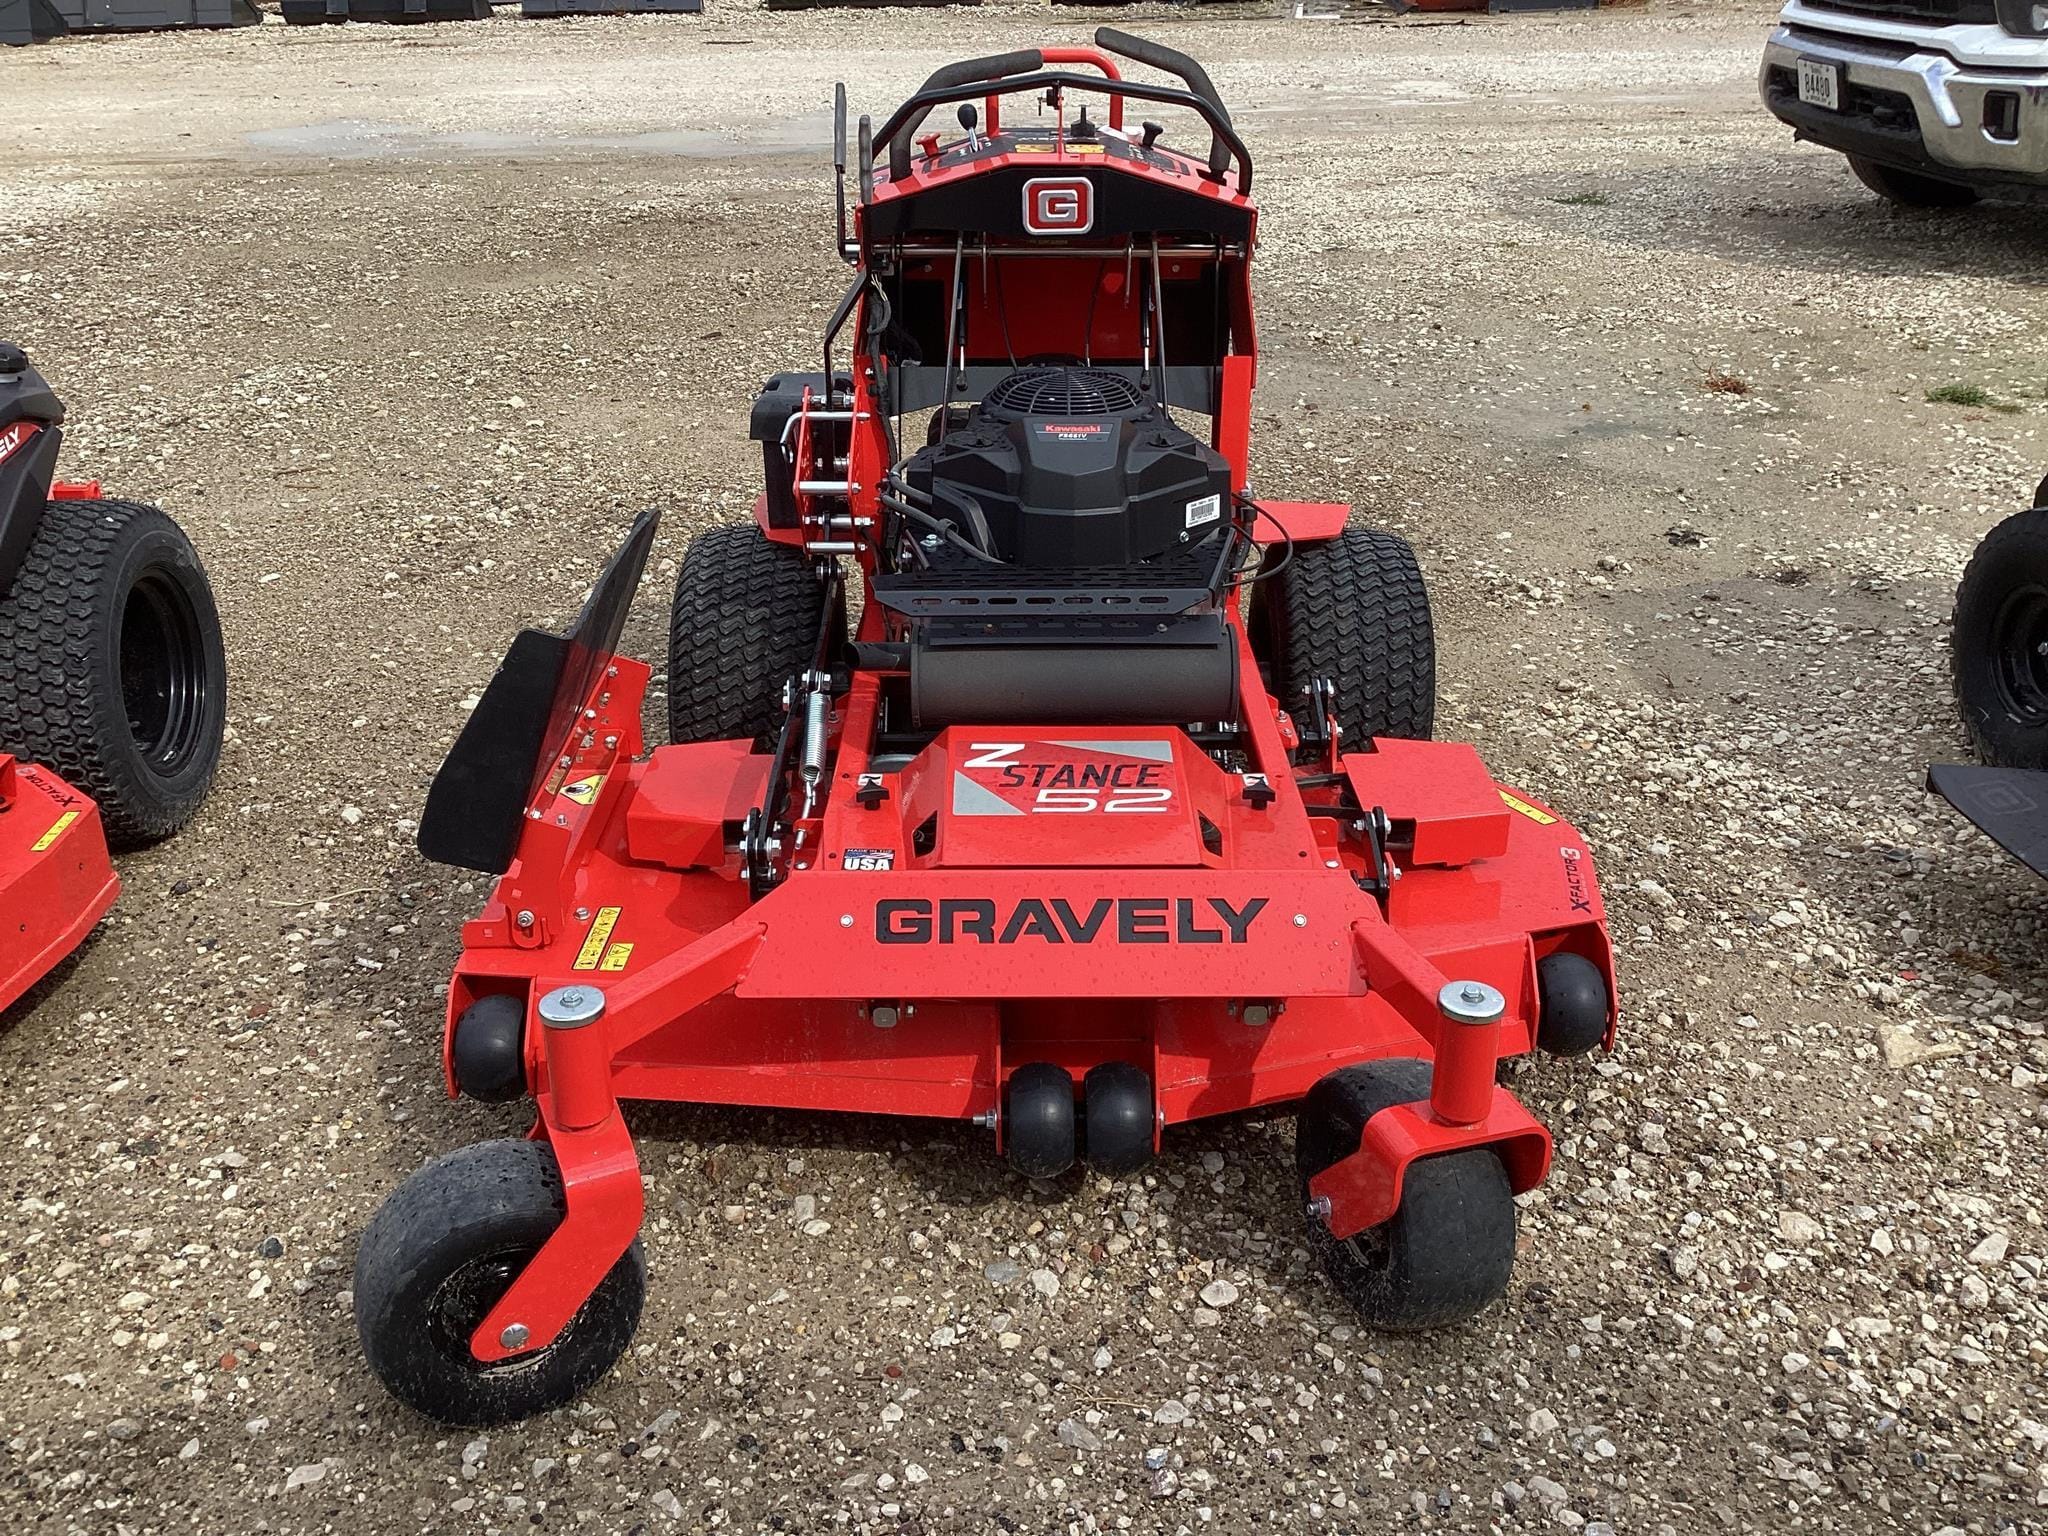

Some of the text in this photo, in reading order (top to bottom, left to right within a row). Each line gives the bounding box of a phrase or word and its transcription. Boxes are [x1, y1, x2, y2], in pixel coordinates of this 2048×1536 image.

[1045, 424, 1101, 432] Kawasaki
[964, 743, 1164, 788] Z STANCE
[1031, 788, 1173, 813] 52
[844, 858, 890, 871] USA
[875, 898, 1270, 944] GRAVELY
